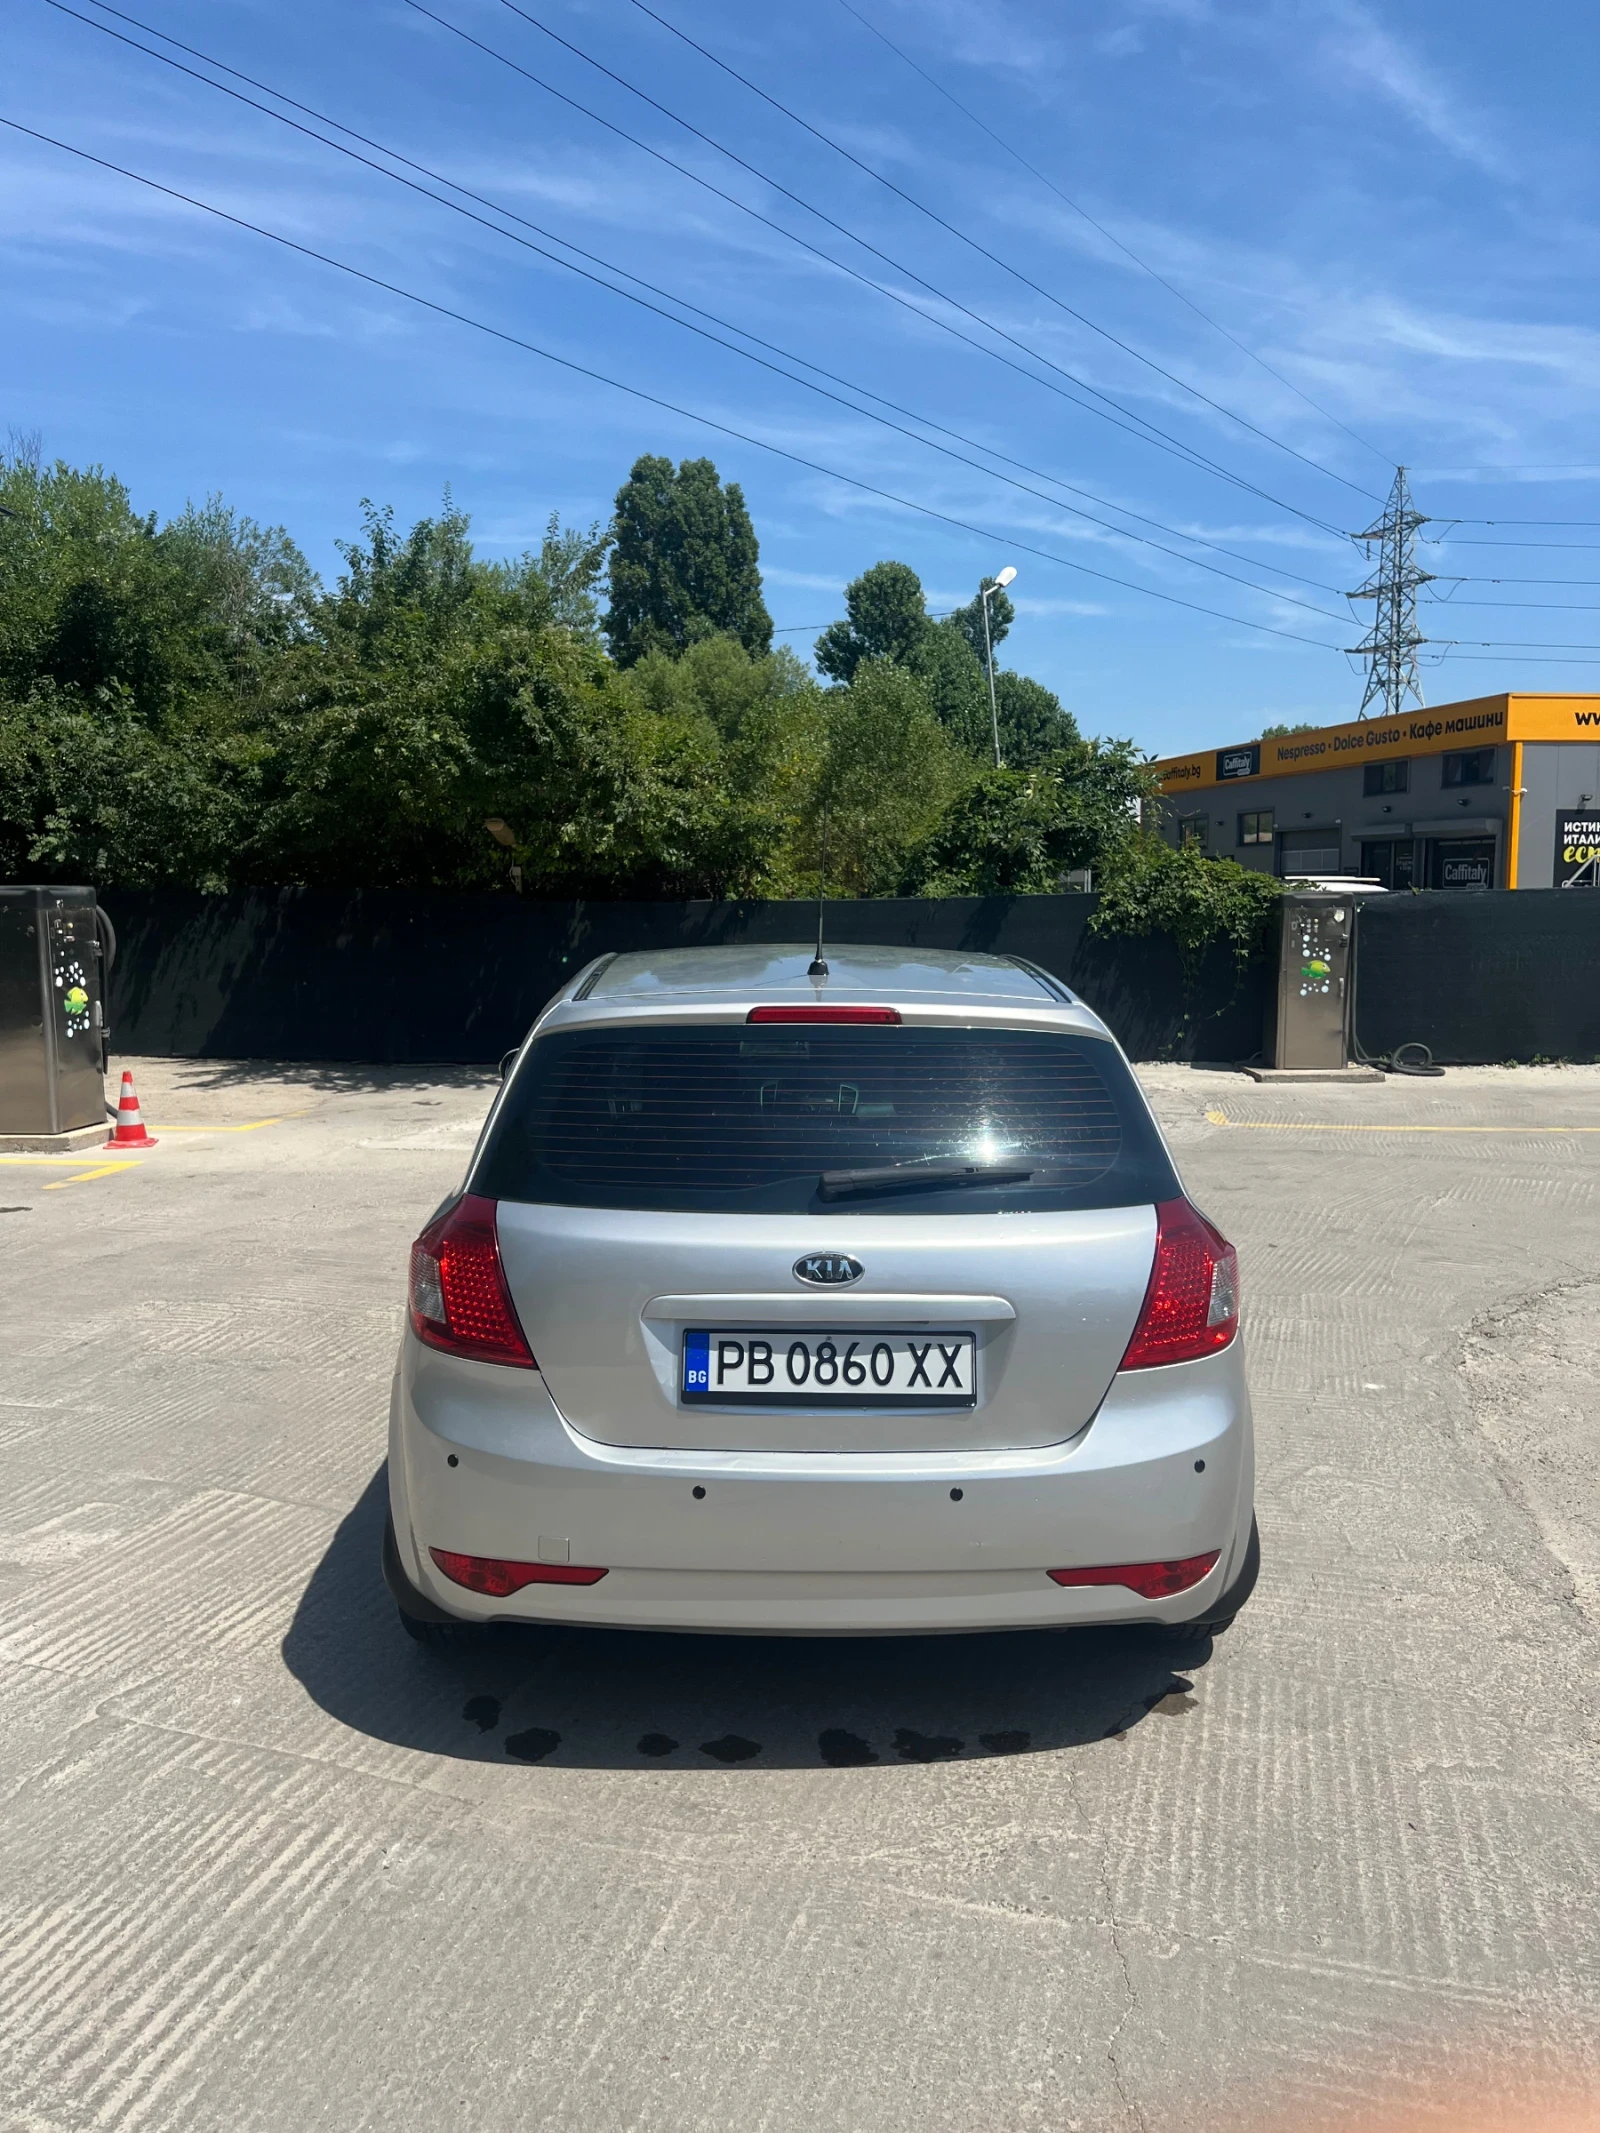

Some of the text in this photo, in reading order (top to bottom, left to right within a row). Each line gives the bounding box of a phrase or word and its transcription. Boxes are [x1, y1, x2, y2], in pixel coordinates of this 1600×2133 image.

[1277, 711, 1503, 761] Nespresso Dolce Gusto Кафе машини
[1225, 756, 1250, 771] Caffitaly
[1445, 863, 1487, 882] Caffitaly
[805, 1259, 854, 1280] KIA
[716, 1340, 963, 1388] PB 0860 XX
[688, 1370, 707, 1384] BG
